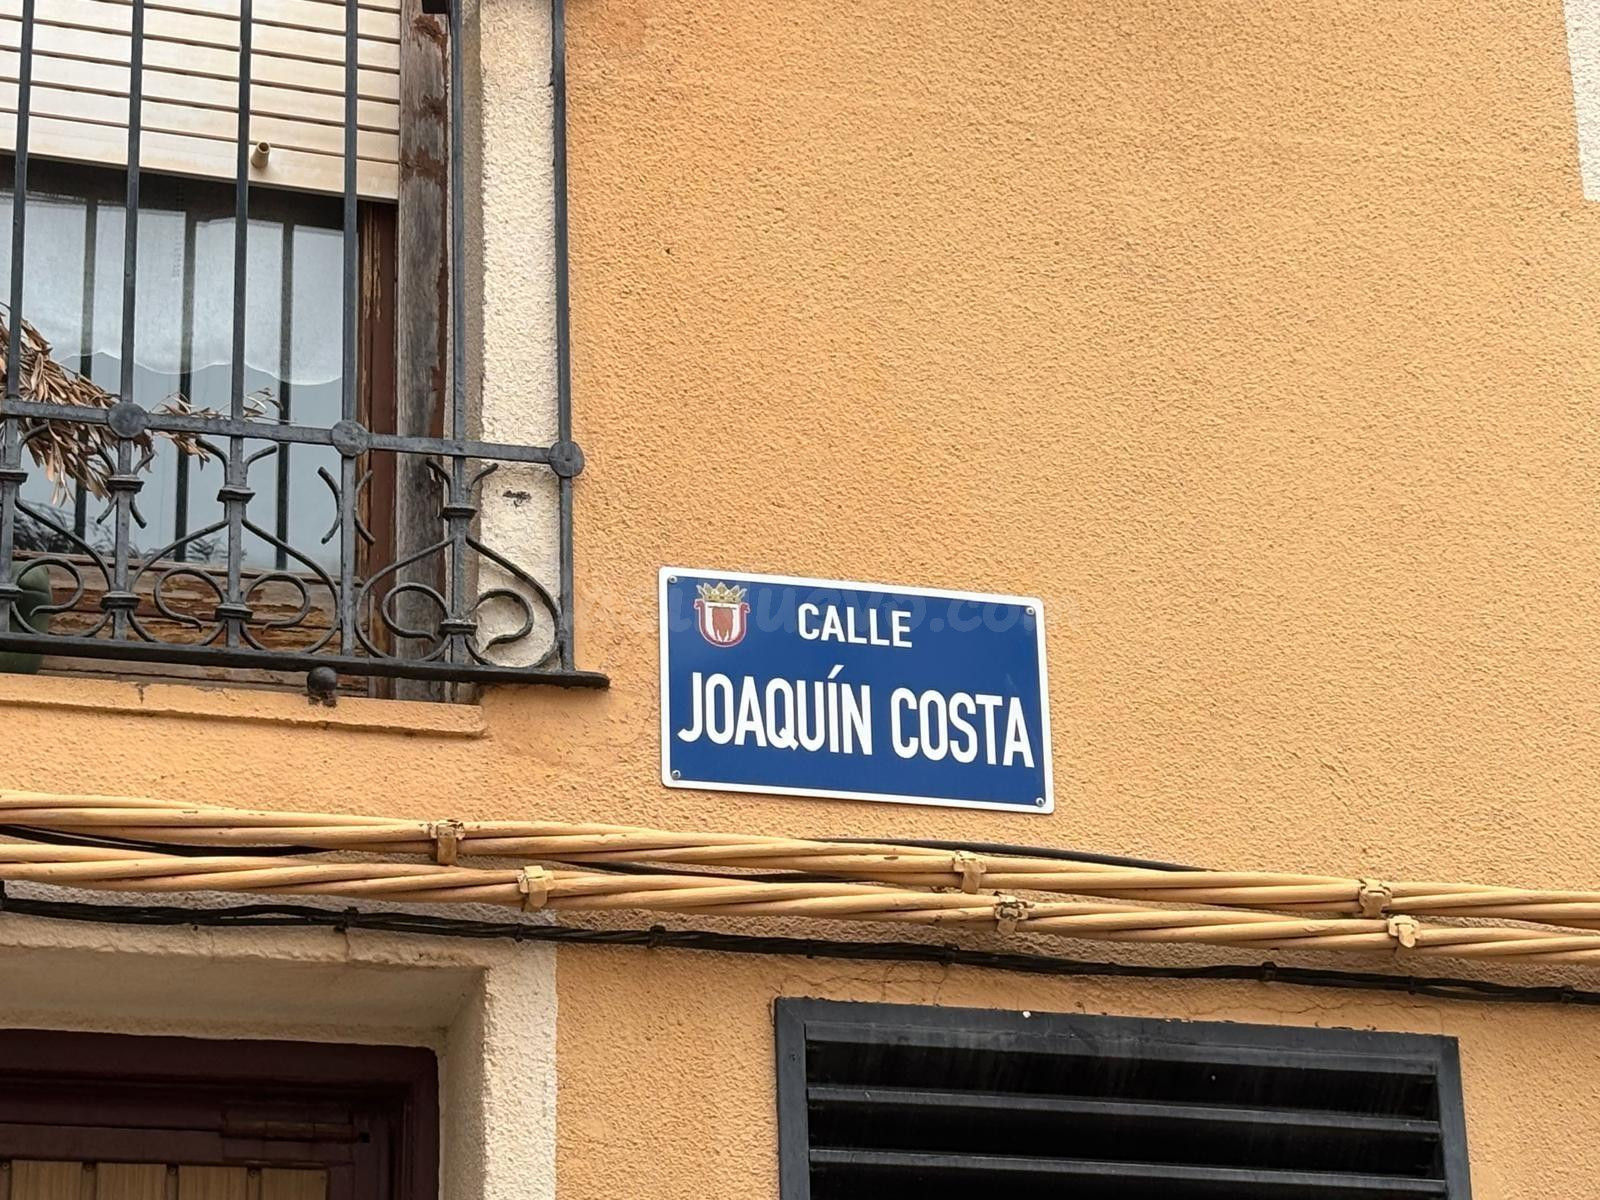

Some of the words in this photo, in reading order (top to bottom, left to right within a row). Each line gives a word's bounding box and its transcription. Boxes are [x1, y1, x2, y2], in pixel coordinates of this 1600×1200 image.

[798, 602, 913, 648] CALLE
[677, 664, 873, 756] JOAQUÍN
[890, 687, 1036, 768] COSTA
